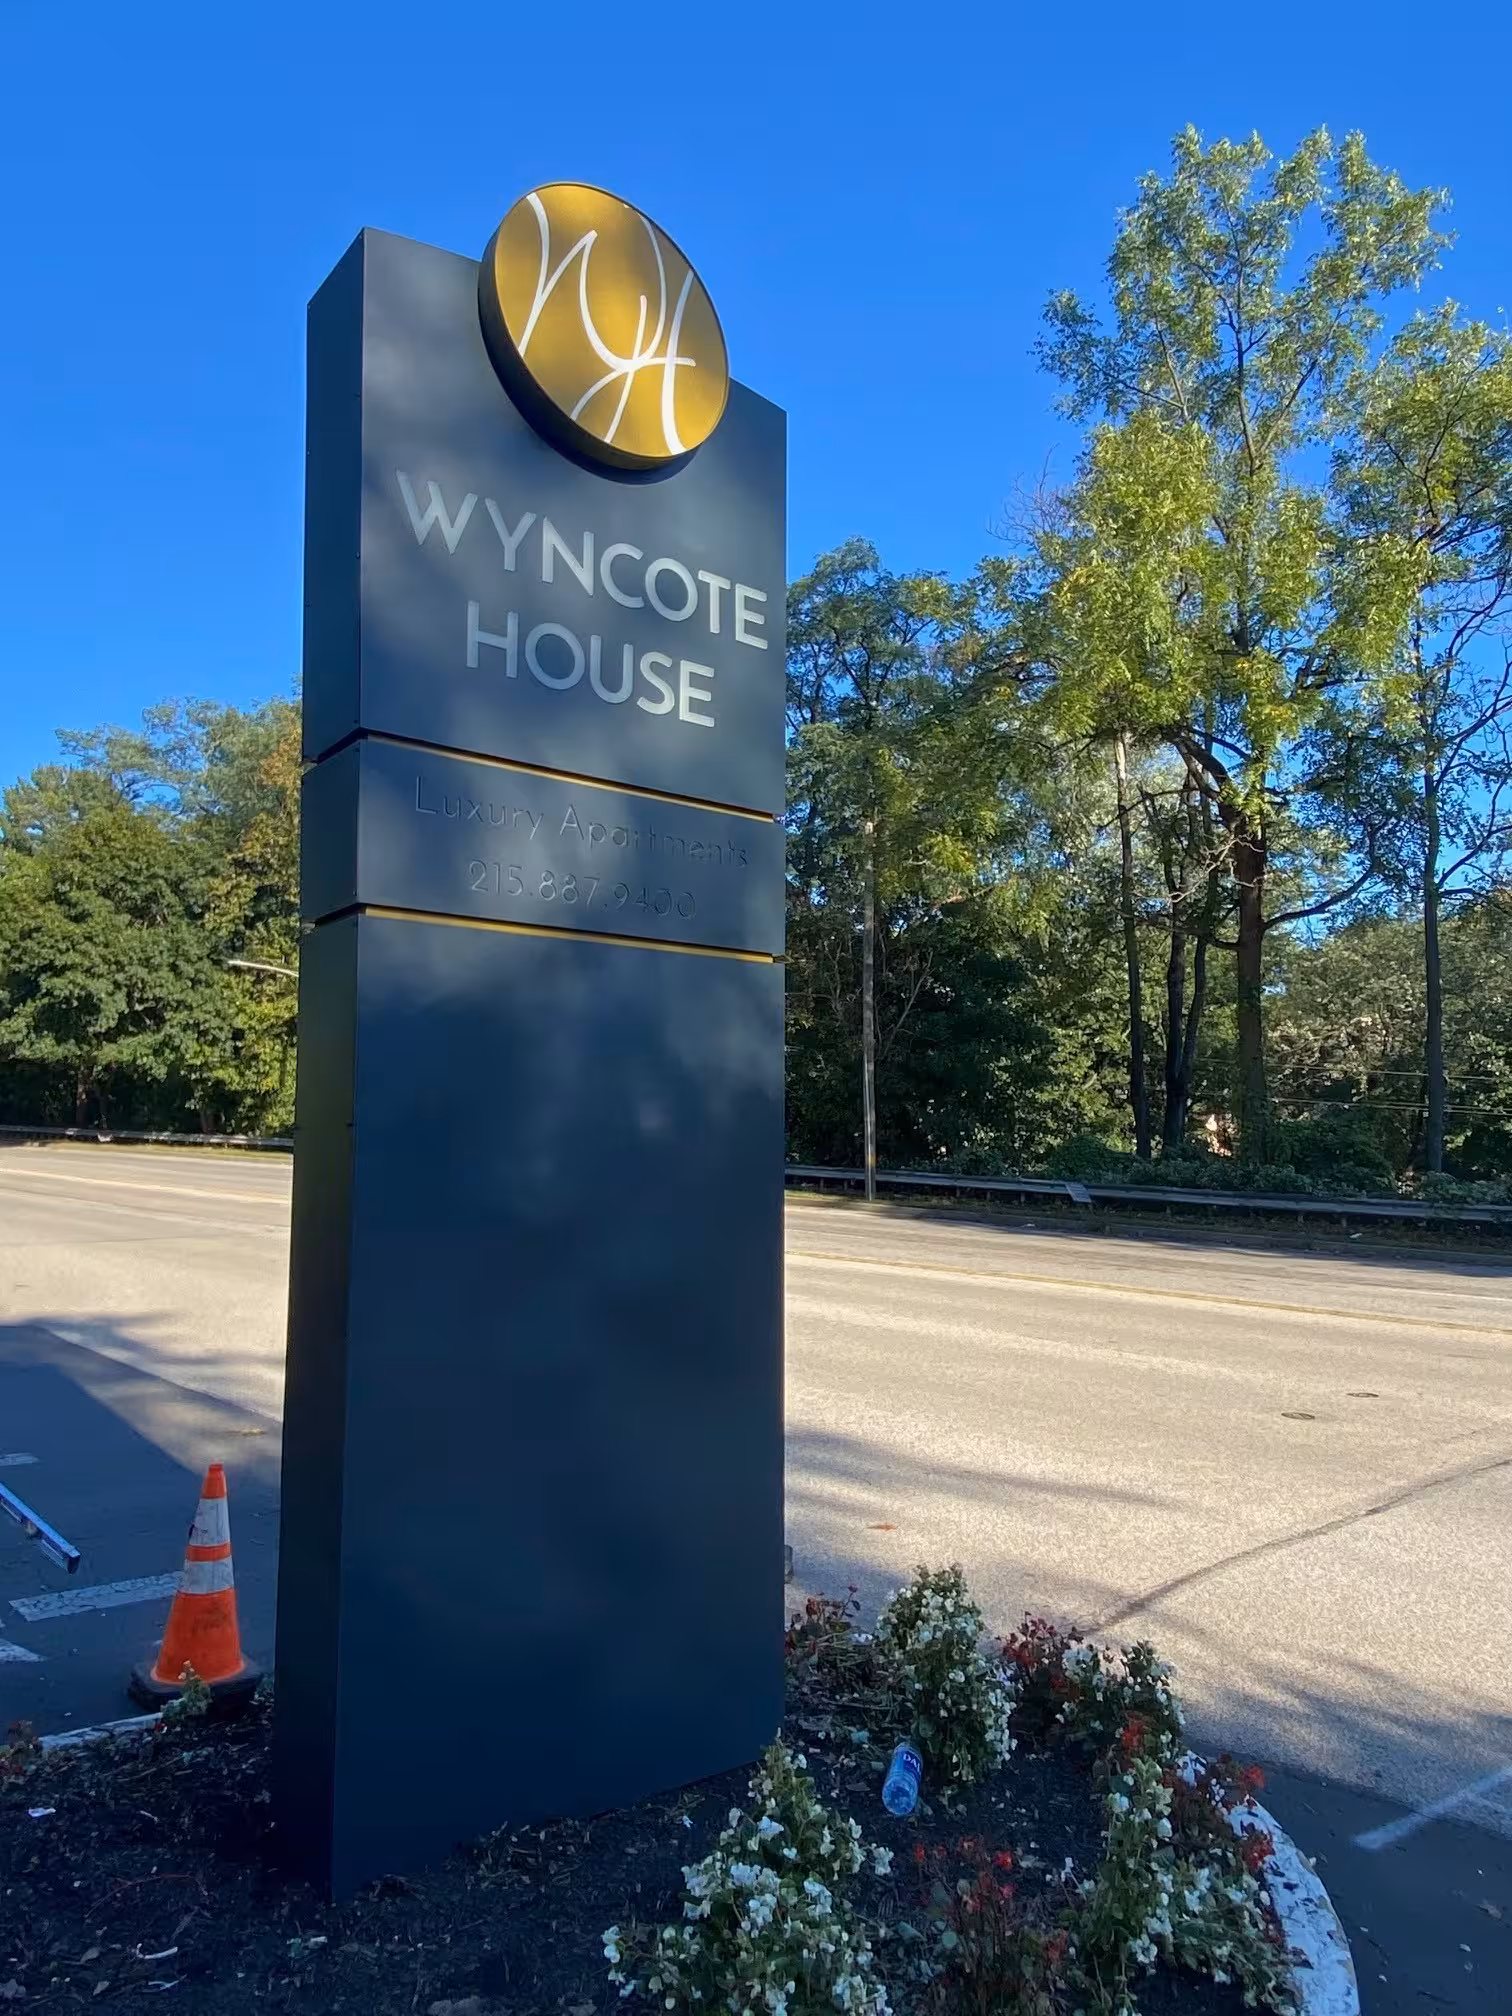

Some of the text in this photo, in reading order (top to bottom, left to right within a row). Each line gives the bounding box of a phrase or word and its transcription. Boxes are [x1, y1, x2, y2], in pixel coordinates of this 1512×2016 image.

[397, 471, 769, 650] WYNCOTE
[466, 600, 715, 728] HOUSE
[416, 776, 748, 868] Luxury Apartments
[469, 859, 697, 920] 215.887.9400
